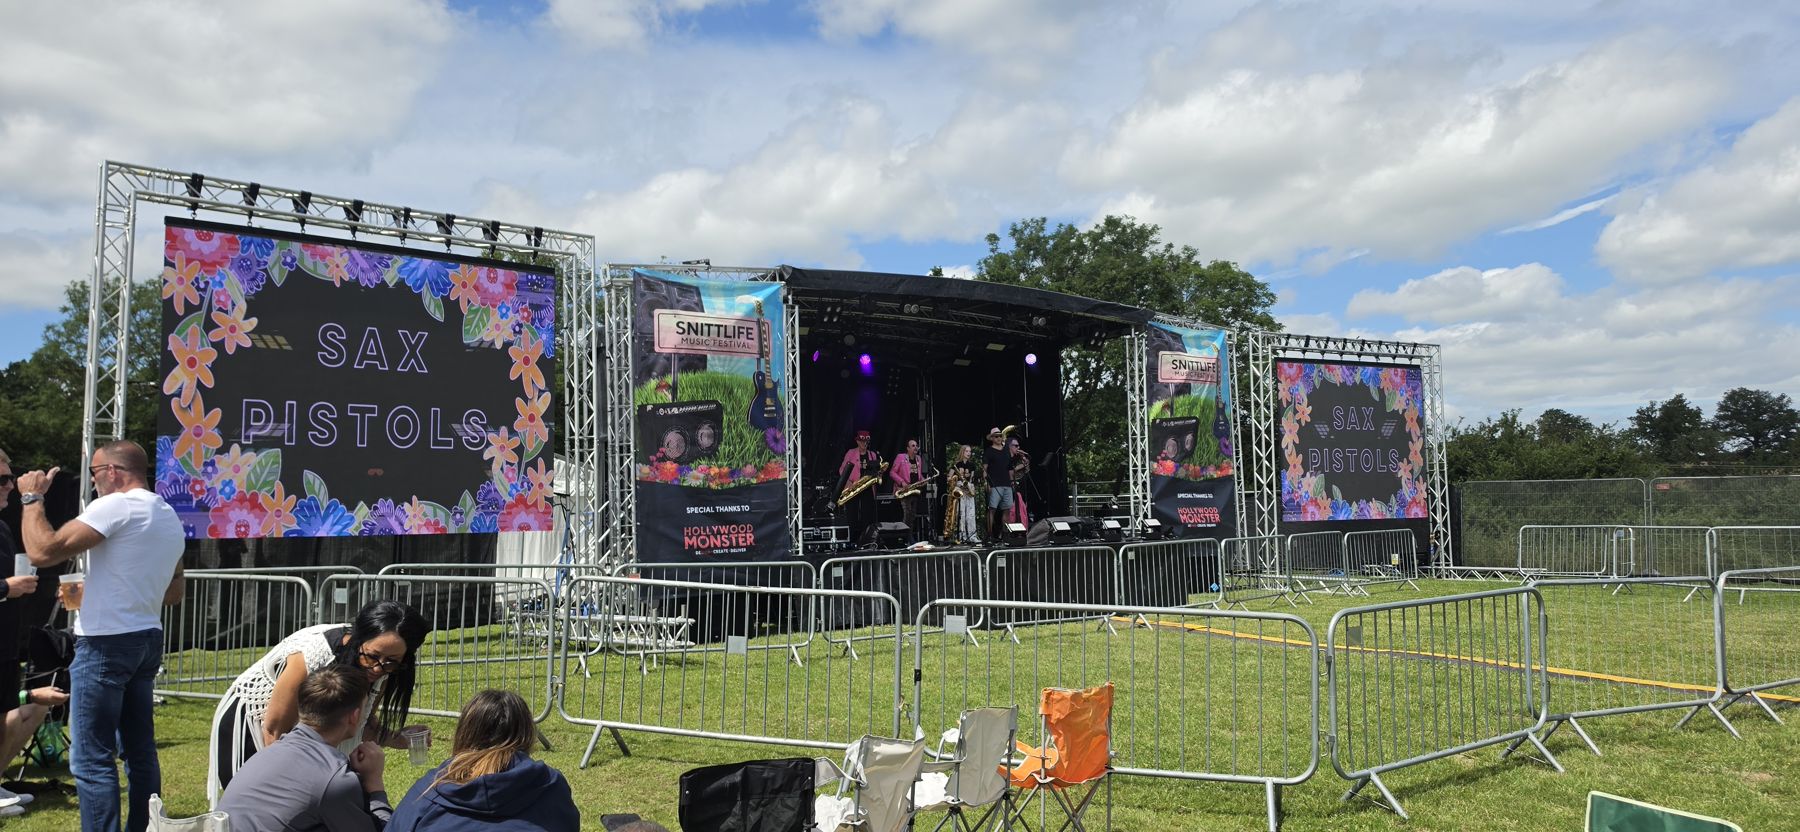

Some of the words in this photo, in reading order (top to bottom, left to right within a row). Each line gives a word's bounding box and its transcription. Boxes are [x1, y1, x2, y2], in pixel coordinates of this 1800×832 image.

[676, 321, 754, 340] SNITTLIFE
[317, 322, 428, 373] SAX
[681, 337, 710, 346] MUSIC
[713, 339, 751, 349] FESTIVAL
[1171, 359, 1216, 373] SNITTLIFE
[241, 399, 488, 450] PISTOLS
[1333, 406, 1375, 431] SAX
[1309, 448, 1400, 473] PISTOLS
[1179, 513, 1220, 523] MONSTER
[684, 524, 753, 536] HOLLYWOOD
[684, 533, 755, 550] MONSTER
